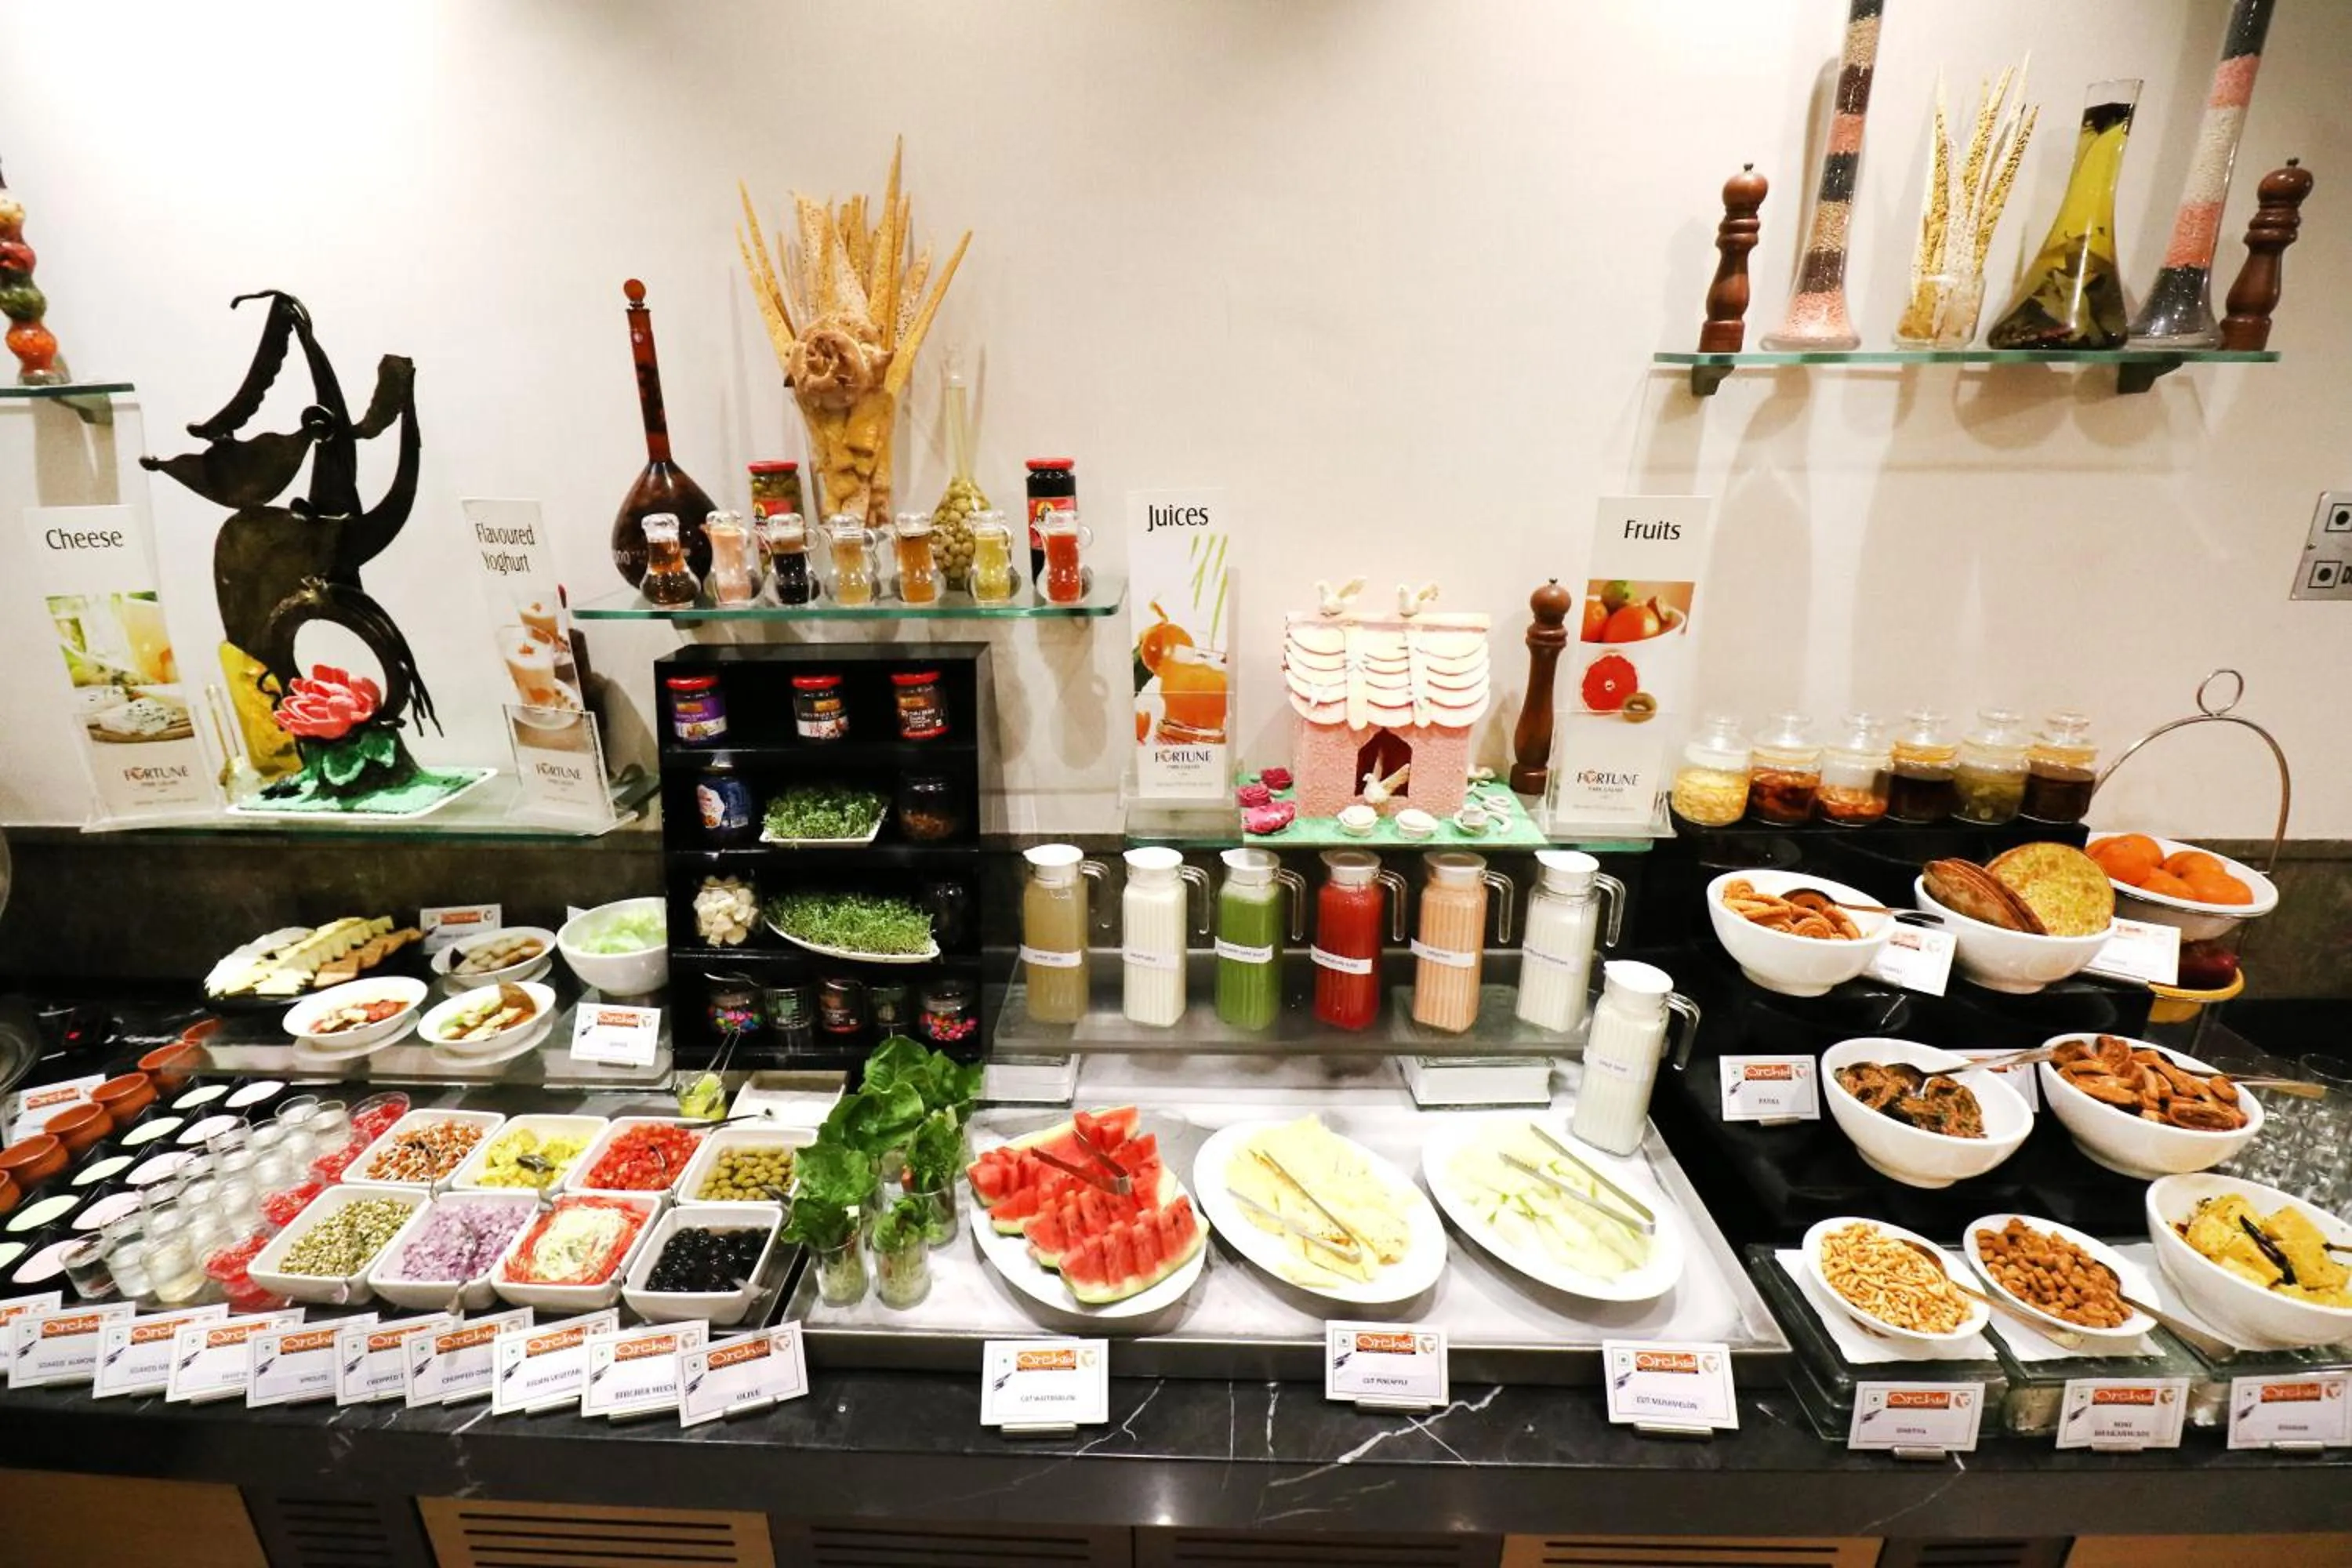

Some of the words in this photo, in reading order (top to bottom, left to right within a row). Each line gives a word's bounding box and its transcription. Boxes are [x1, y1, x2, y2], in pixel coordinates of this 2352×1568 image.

[1147, 504, 1209, 532] Juices
[45, 528, 124, 550] Cheese
[475, 522, 535, 545] Flavoured
[1624, 520, 1682, 540] Fruits
[481, 550, 531, 575] Yoghurt
[1155, 749, 1211, 763] FORTUNE
[123, 764, 189, 781] FORTUNE
[536, 762, 582, 780] FORTUNE
[1577, 769, 1640, 786] FORTUNE
[1357, 1335, 1414, 1348] Orchid
[708, 1340, 768, 1365] Orchid
[1637, 1354, 1696, 1367] Orchid
[1889, 1393, 1948, 1404] Orchid
